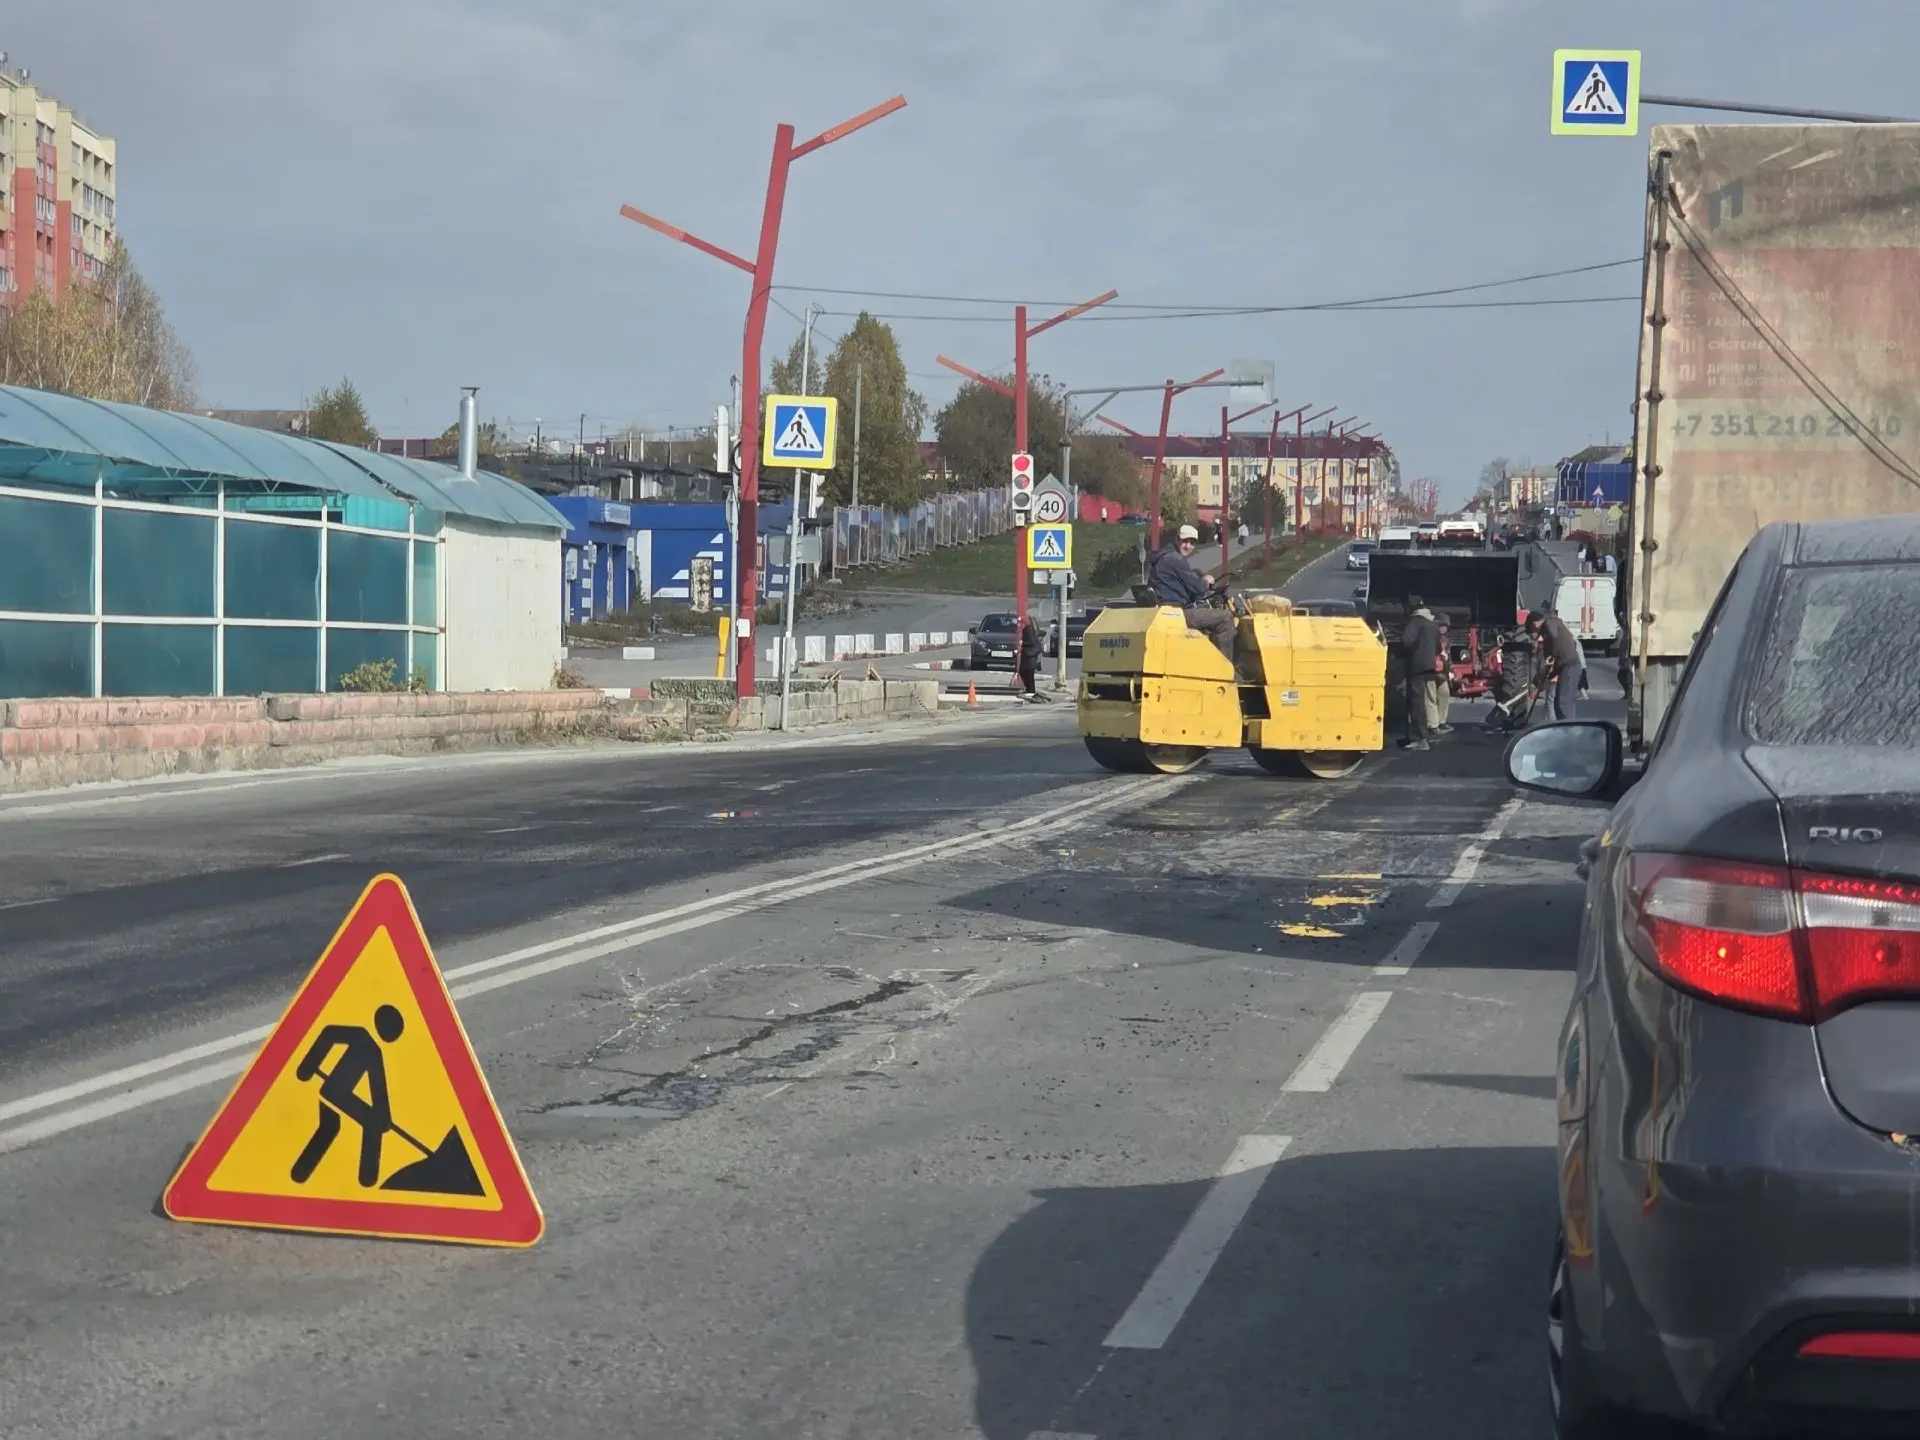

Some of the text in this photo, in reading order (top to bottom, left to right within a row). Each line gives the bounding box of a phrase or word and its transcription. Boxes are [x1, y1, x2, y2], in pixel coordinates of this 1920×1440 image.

[1670, 414, 1703, 437] +7
[1709, 414, 1758, 438] 351
[1765, 414, 1817, 437] 210
[1868, 414, 1902, 437] 10
[1040, 500, 1060, 514] 40
[1099, 638, 1130, 649] KOMATSU
[1809, 825, 1884, 843] RIO
